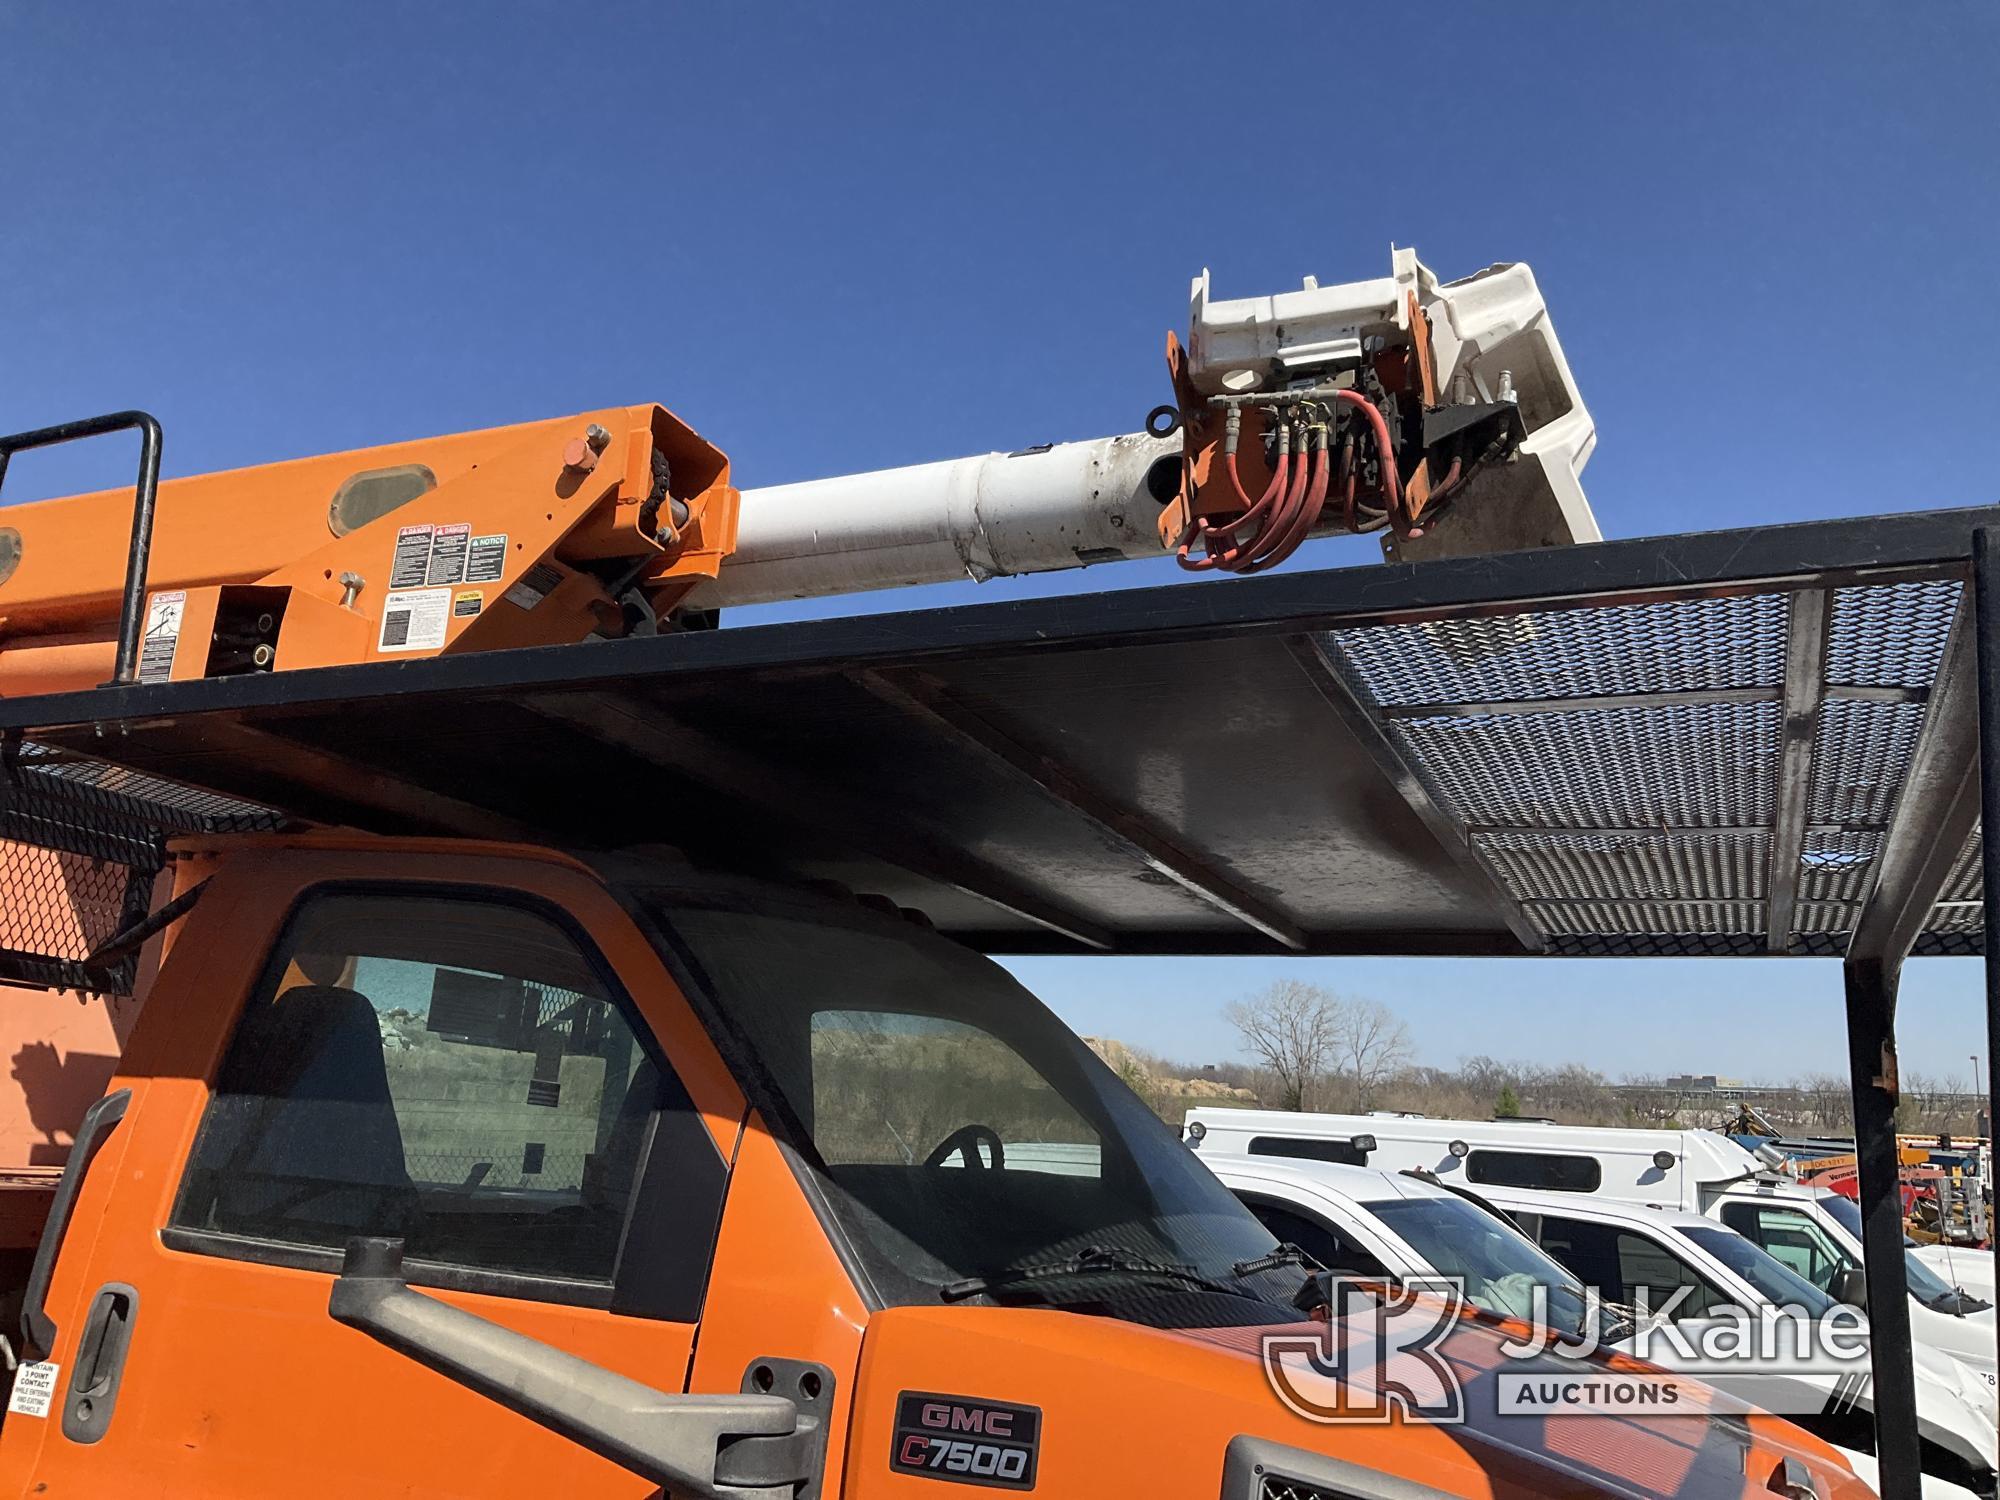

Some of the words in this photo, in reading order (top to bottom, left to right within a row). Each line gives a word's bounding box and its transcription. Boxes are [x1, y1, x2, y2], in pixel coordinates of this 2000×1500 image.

[479, 536, 504, 545] NOTICE
[30, 1371, 49, 1379] POINT
[20, 1378, 50, 1388] CONTACT
[15, 1387, 29, 1395] WHILE
[29, 1388, 51, 1398] ENTERING
[26, 1397, 45, 1406] EXITING
[17, 1404, 40, 1414] VEHICLE
[921, 1403, 1013, 1437] GMC
[900, 1435, 1028, 1479] C7500
